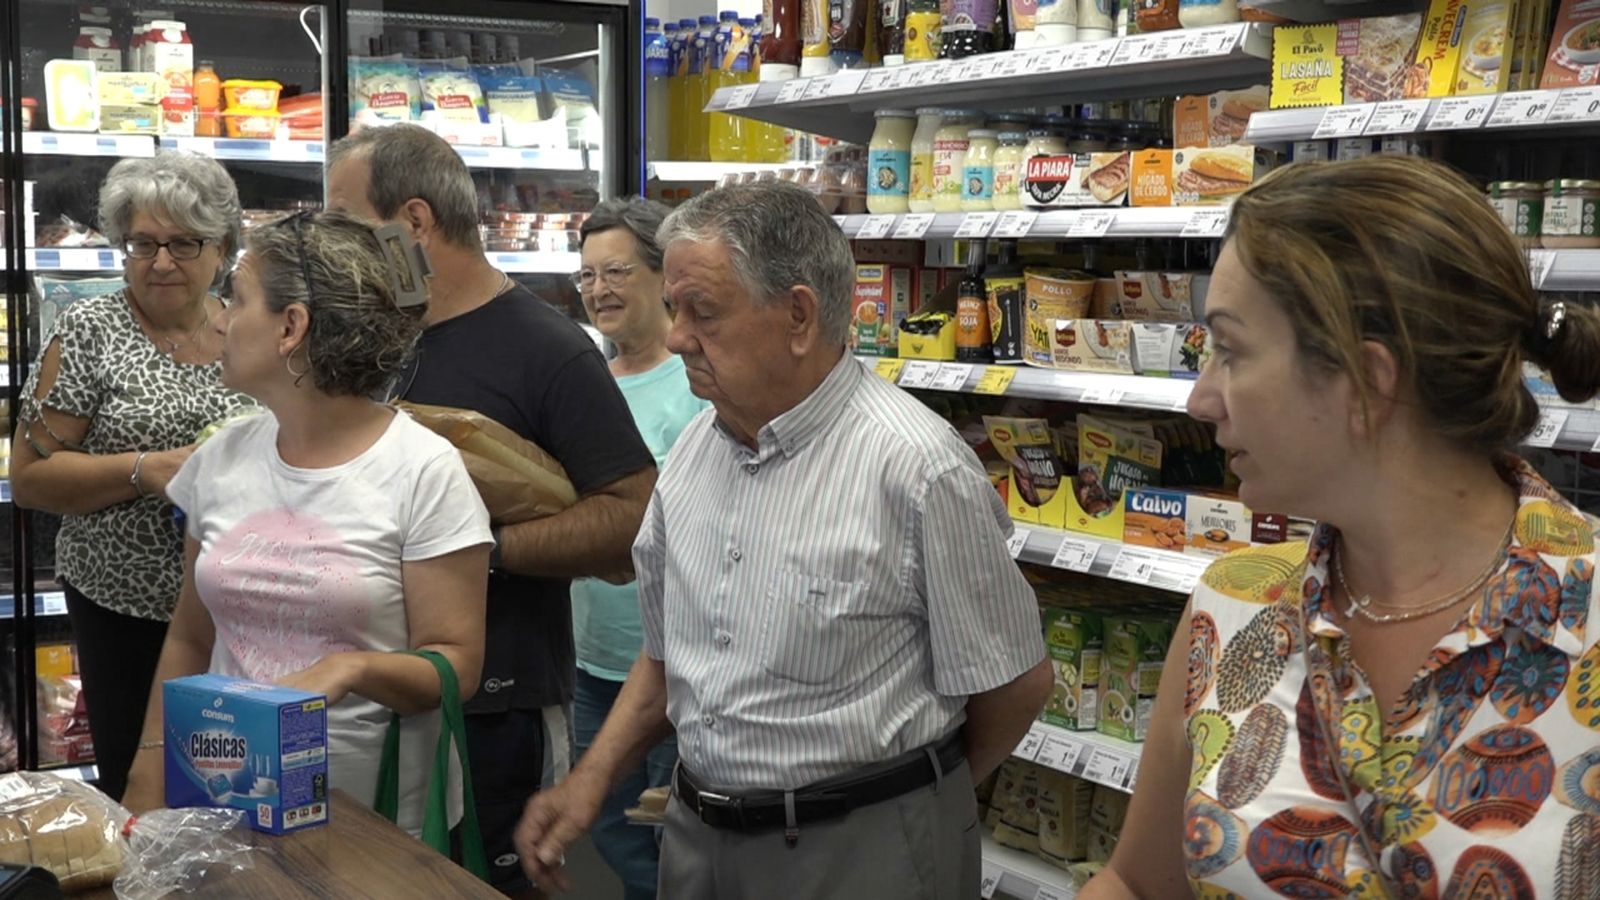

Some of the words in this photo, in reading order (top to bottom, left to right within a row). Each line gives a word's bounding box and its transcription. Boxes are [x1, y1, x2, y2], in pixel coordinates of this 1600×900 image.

[1434, 0, 1459, 60] VECREM
[1292, 46, 1301, 54] El
[1281, 60, 1333, 80] LASAÑA
[1029, 162, 1040, 178] LA
[1041, 161, 1071, 178] PIARA
[1138, 172, 1166, 186] HÍGADO
[1135, 186, 1145, 197] DE
[1145, 186, 1168, 197] CERDO
[1042, 284, 1073, 296] POLLO
[959, 301, 980, 310] HEINZ
[960, 316, 978, 327] SOJA
[1132, 493, 1182, 516] Calvo
[202, 708, 235, 723] consum
[191, 732, 246, 758] Clásicas
[259, 805, 270, 820] 50
